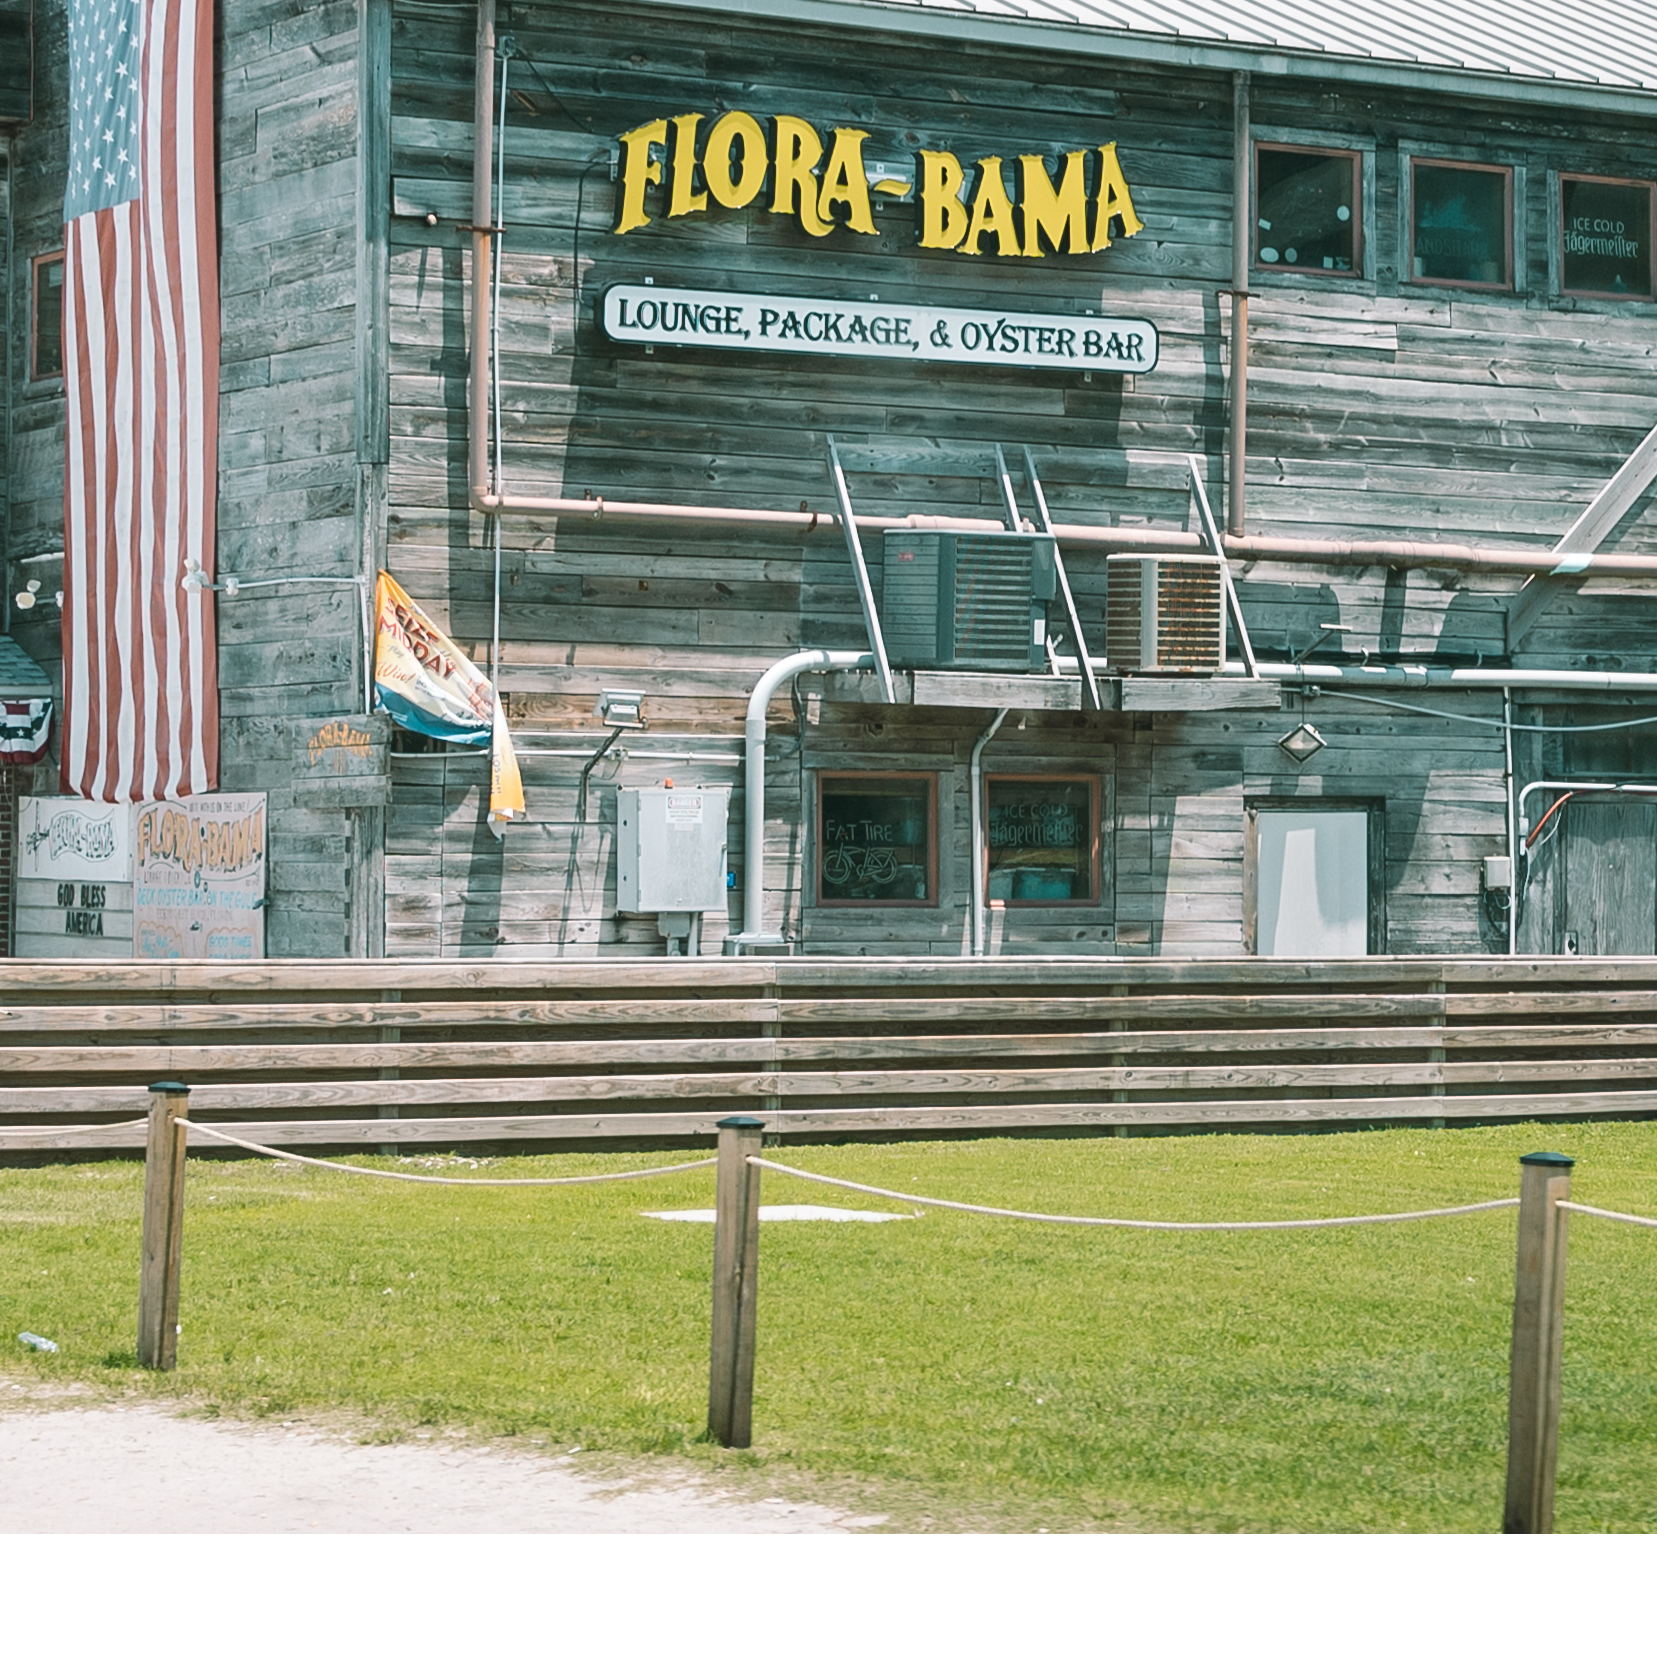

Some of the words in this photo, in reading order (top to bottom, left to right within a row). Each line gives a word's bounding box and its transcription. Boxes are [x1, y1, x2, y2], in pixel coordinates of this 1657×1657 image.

[613, 109, 1145, 258] FLORA-BAMA
[1573, 217, 1590, 232] ICE
[1593, 219, 1625, 234] COLD
[618, 298, 751, 341] LOUNGE,
[759, 308, 920, 352] PACKAGE,
[929, 319, 953, 348] &
[960, 317, 1077, 358] OYSTER
[1082, 330, 1146, 362] BAR
[385, 597, 440, 643] SEIZE
[378, 614, 457, 680] MIDDAY
[378, 661, 417, 684] Win!
[1004, 803, 1026, 818] ICE
[1030, 803, 1069, 818] COLD
[138, 806, 263, 873] FLORA-BAMA
[826, 819, 857, 841] FAT
[860, 819, 892, 842] TIRE
[57, 883, 75, 907] GOD
[80, 884, 106, 908] BLESS
[158, 888, 186, 906] OYSTER
[220, 891, 234, 909] THE
[65, 911, 103, 936] AMERICA
